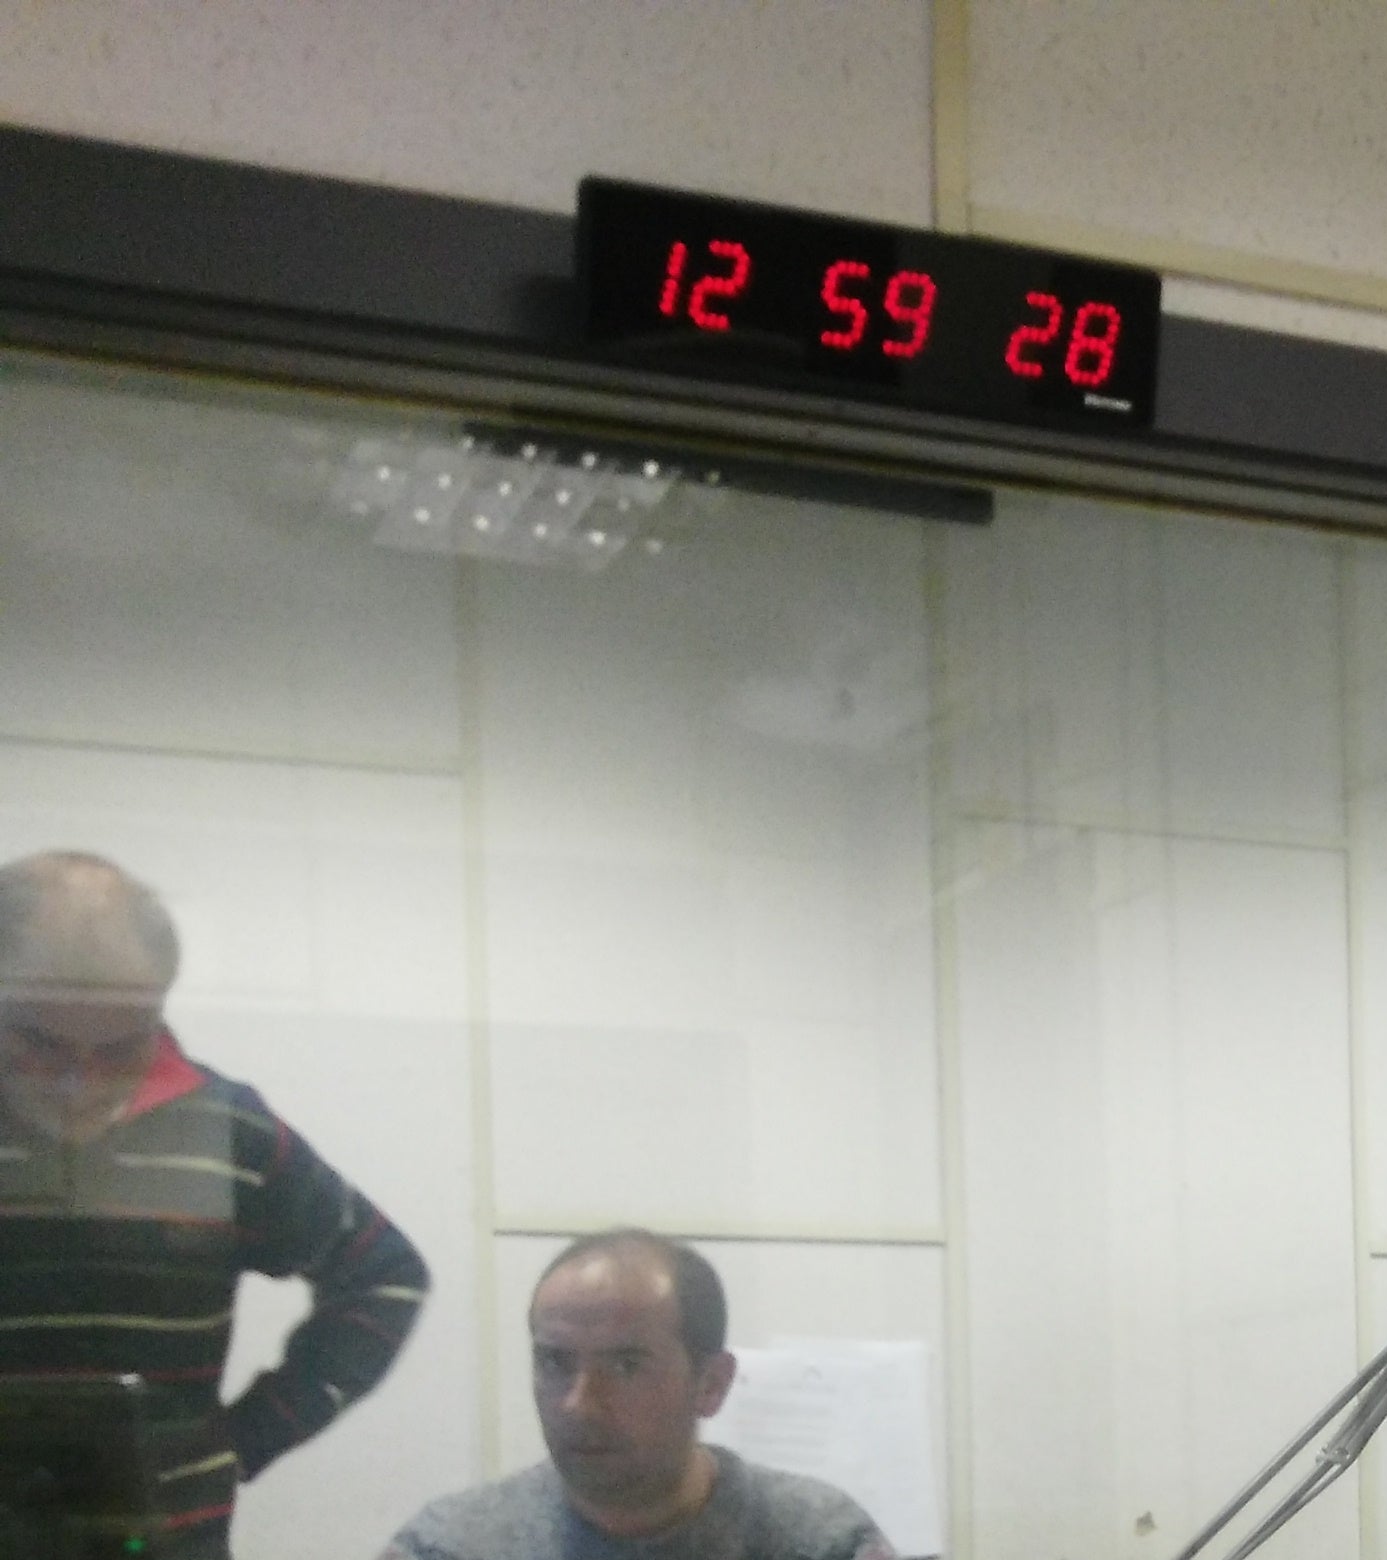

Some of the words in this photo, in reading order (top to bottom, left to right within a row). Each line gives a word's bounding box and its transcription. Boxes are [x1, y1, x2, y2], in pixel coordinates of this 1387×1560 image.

[659, 240, 751, 330] 12
[821, 260, 937, 357] 59
[1005, 292, 1121, 387] 28
